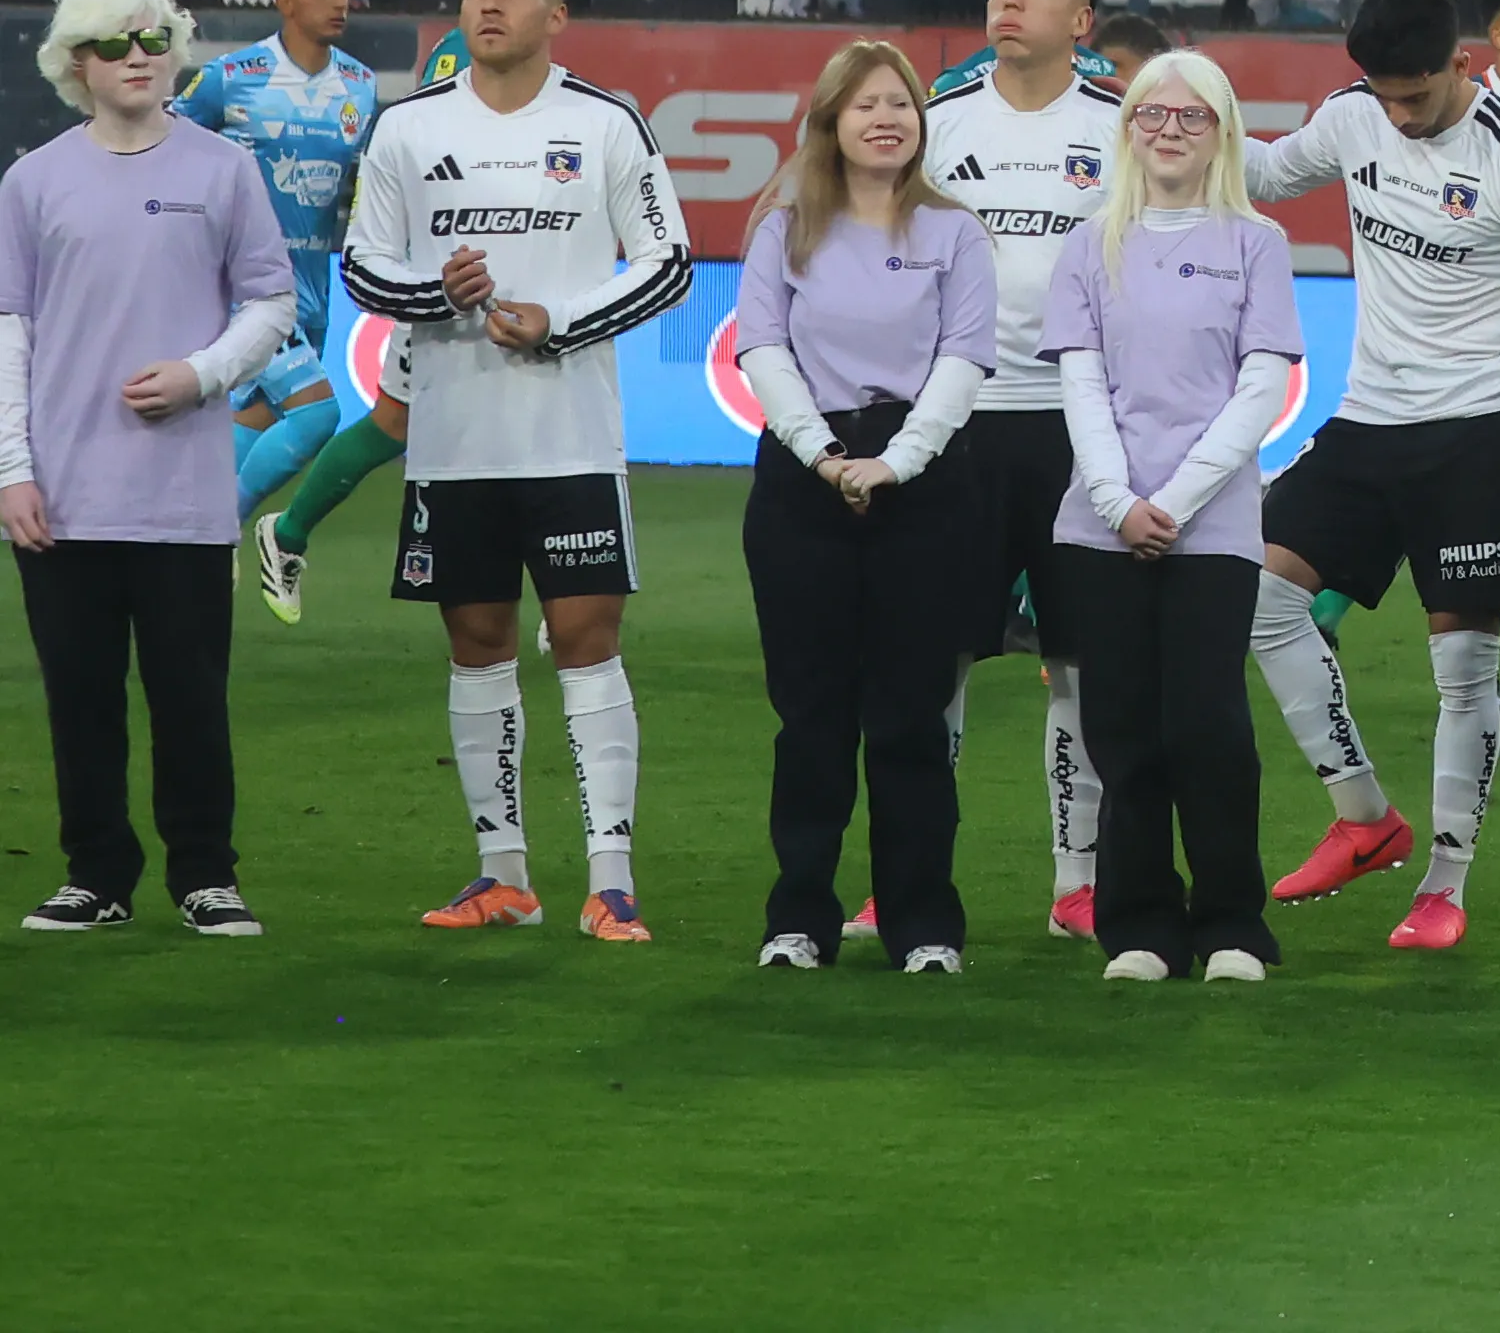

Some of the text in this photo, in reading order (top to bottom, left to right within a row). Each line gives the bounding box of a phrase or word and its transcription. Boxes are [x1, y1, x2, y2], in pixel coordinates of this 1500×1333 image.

[469, 160, 538, 170] JETOUR
[988, 161, 1060, 173] JETOUR
[1383, 175, 1439, 199] JETOUR
[543, 529, 617, 551] PHILIPS
[548, 550, 618, 567] TV & Audio
[1440, 566, 1454, 581] TV
[1456, 566, 1466, 580] &
